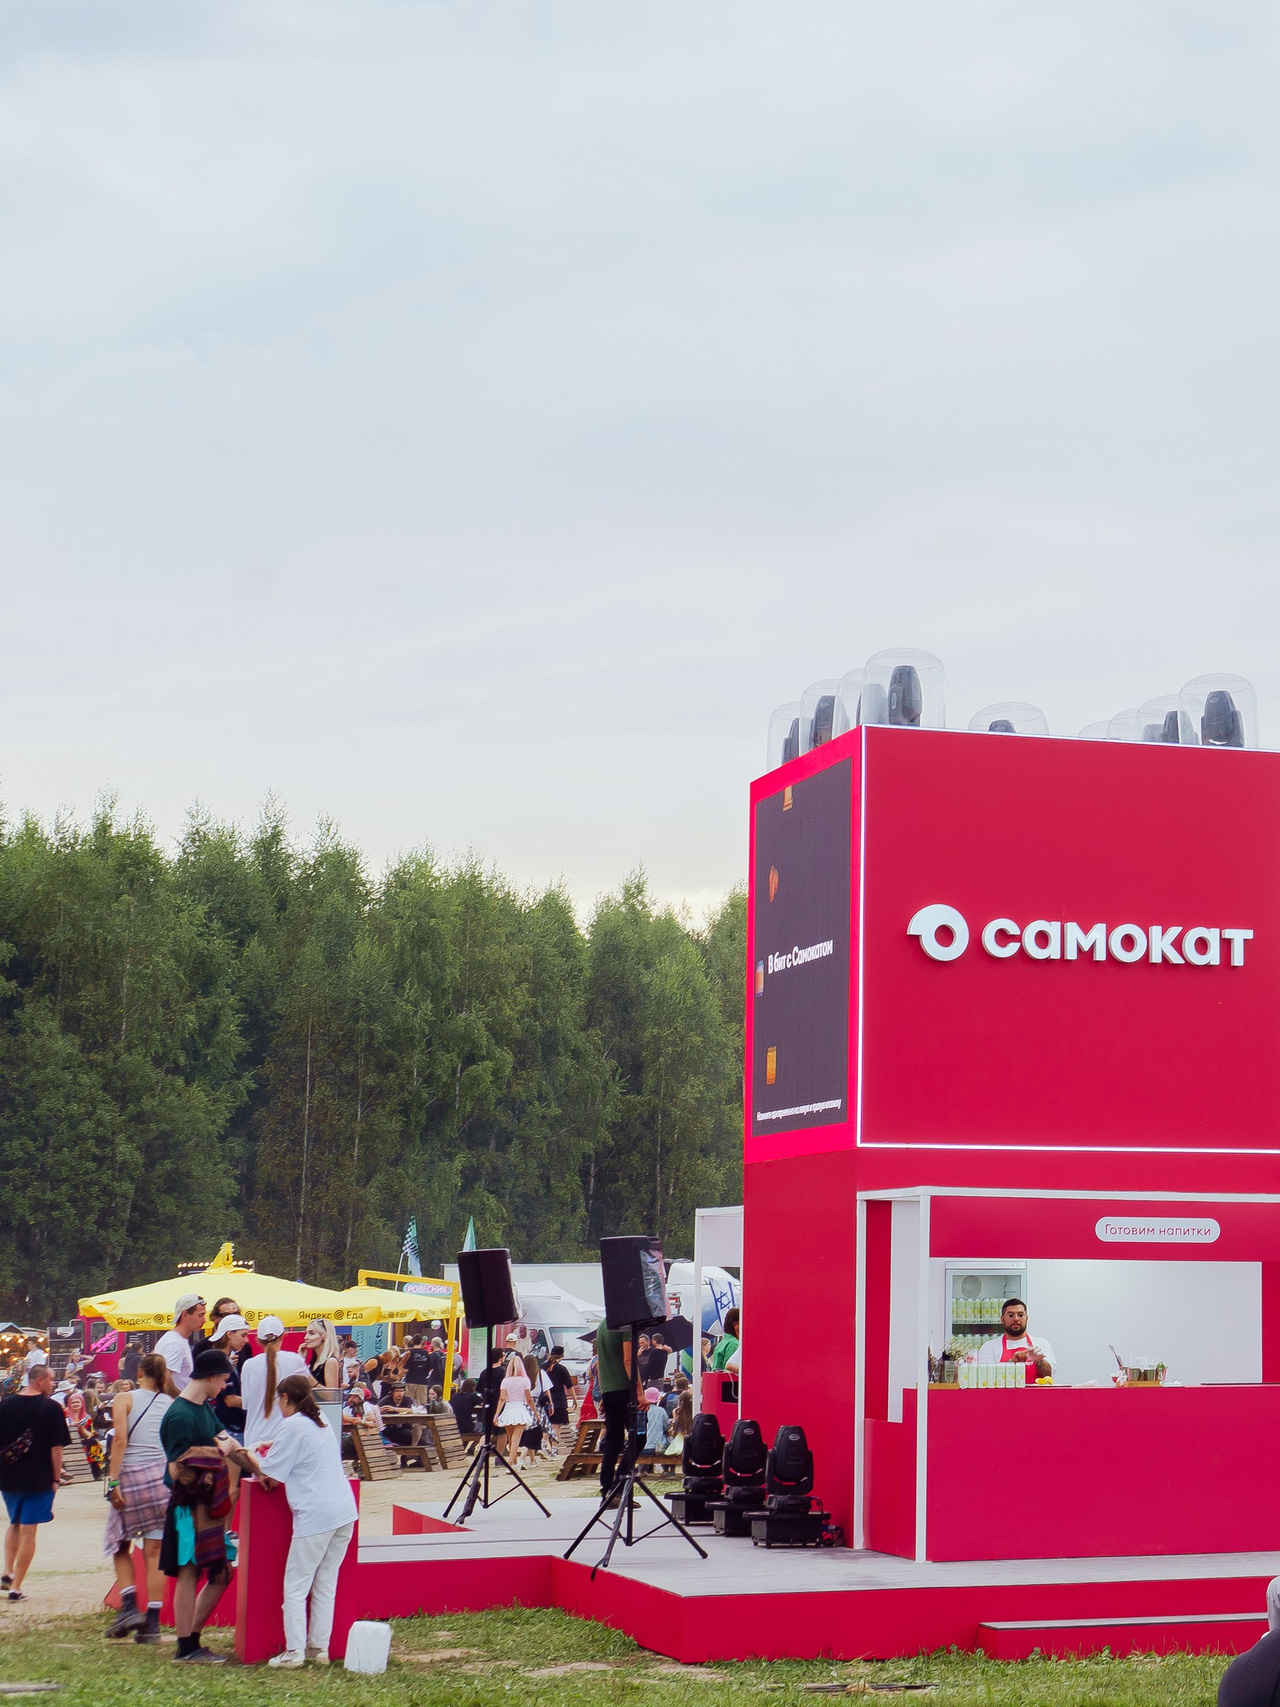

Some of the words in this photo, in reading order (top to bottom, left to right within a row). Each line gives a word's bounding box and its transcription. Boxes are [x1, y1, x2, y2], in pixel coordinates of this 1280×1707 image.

[768, 954, 774, 974] В
[1105, 1224, 1155, 1236] Готовим
[1159, 1226, 1211, 1236] напитки
[299, 1311, 332, 1320] Яндекс
[346, 1310, 363, 1319] Еда
[117, 1316, 152, 1326] Яндекс
